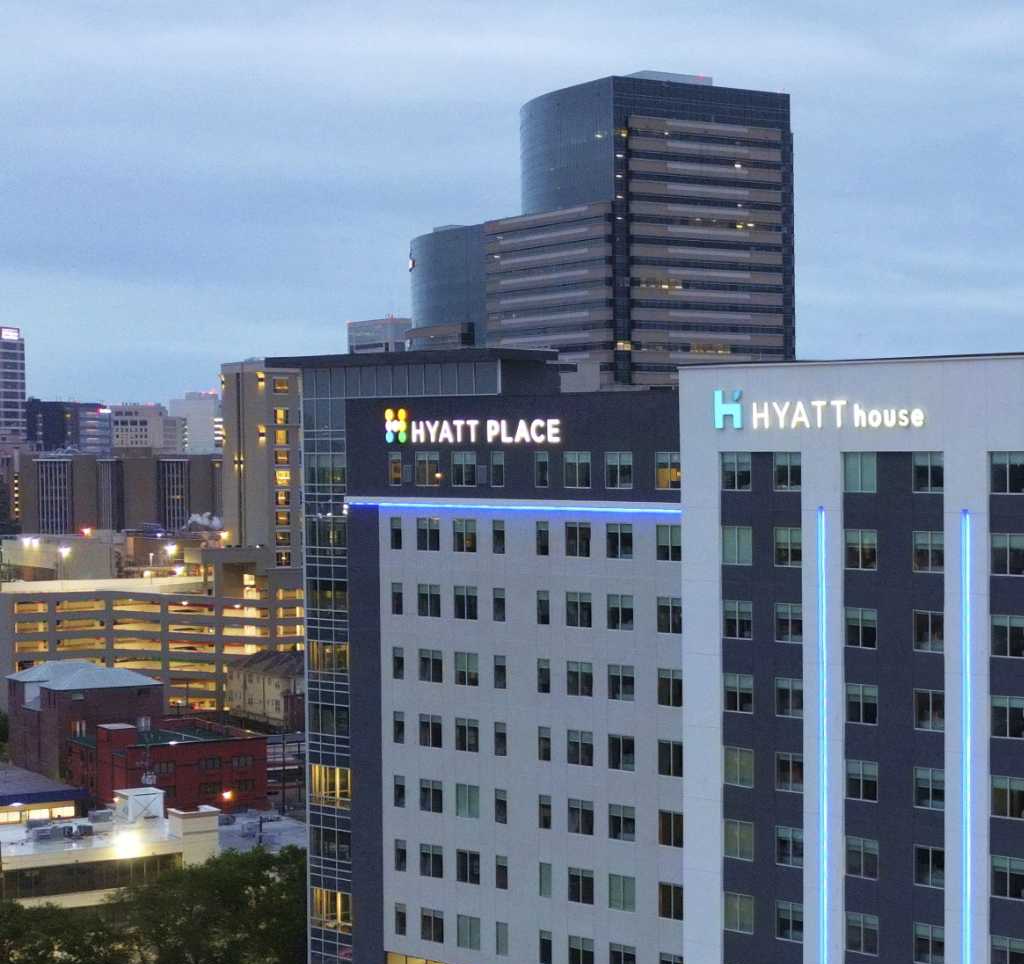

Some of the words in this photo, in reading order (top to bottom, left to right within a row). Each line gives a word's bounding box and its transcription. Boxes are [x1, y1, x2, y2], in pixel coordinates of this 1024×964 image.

[751, 400, 847, 430] HYATT
[852, 403, 925, 428] house
[410, 419, 480, 443] HYATT
[486, 418, 561, 443] PLACE
